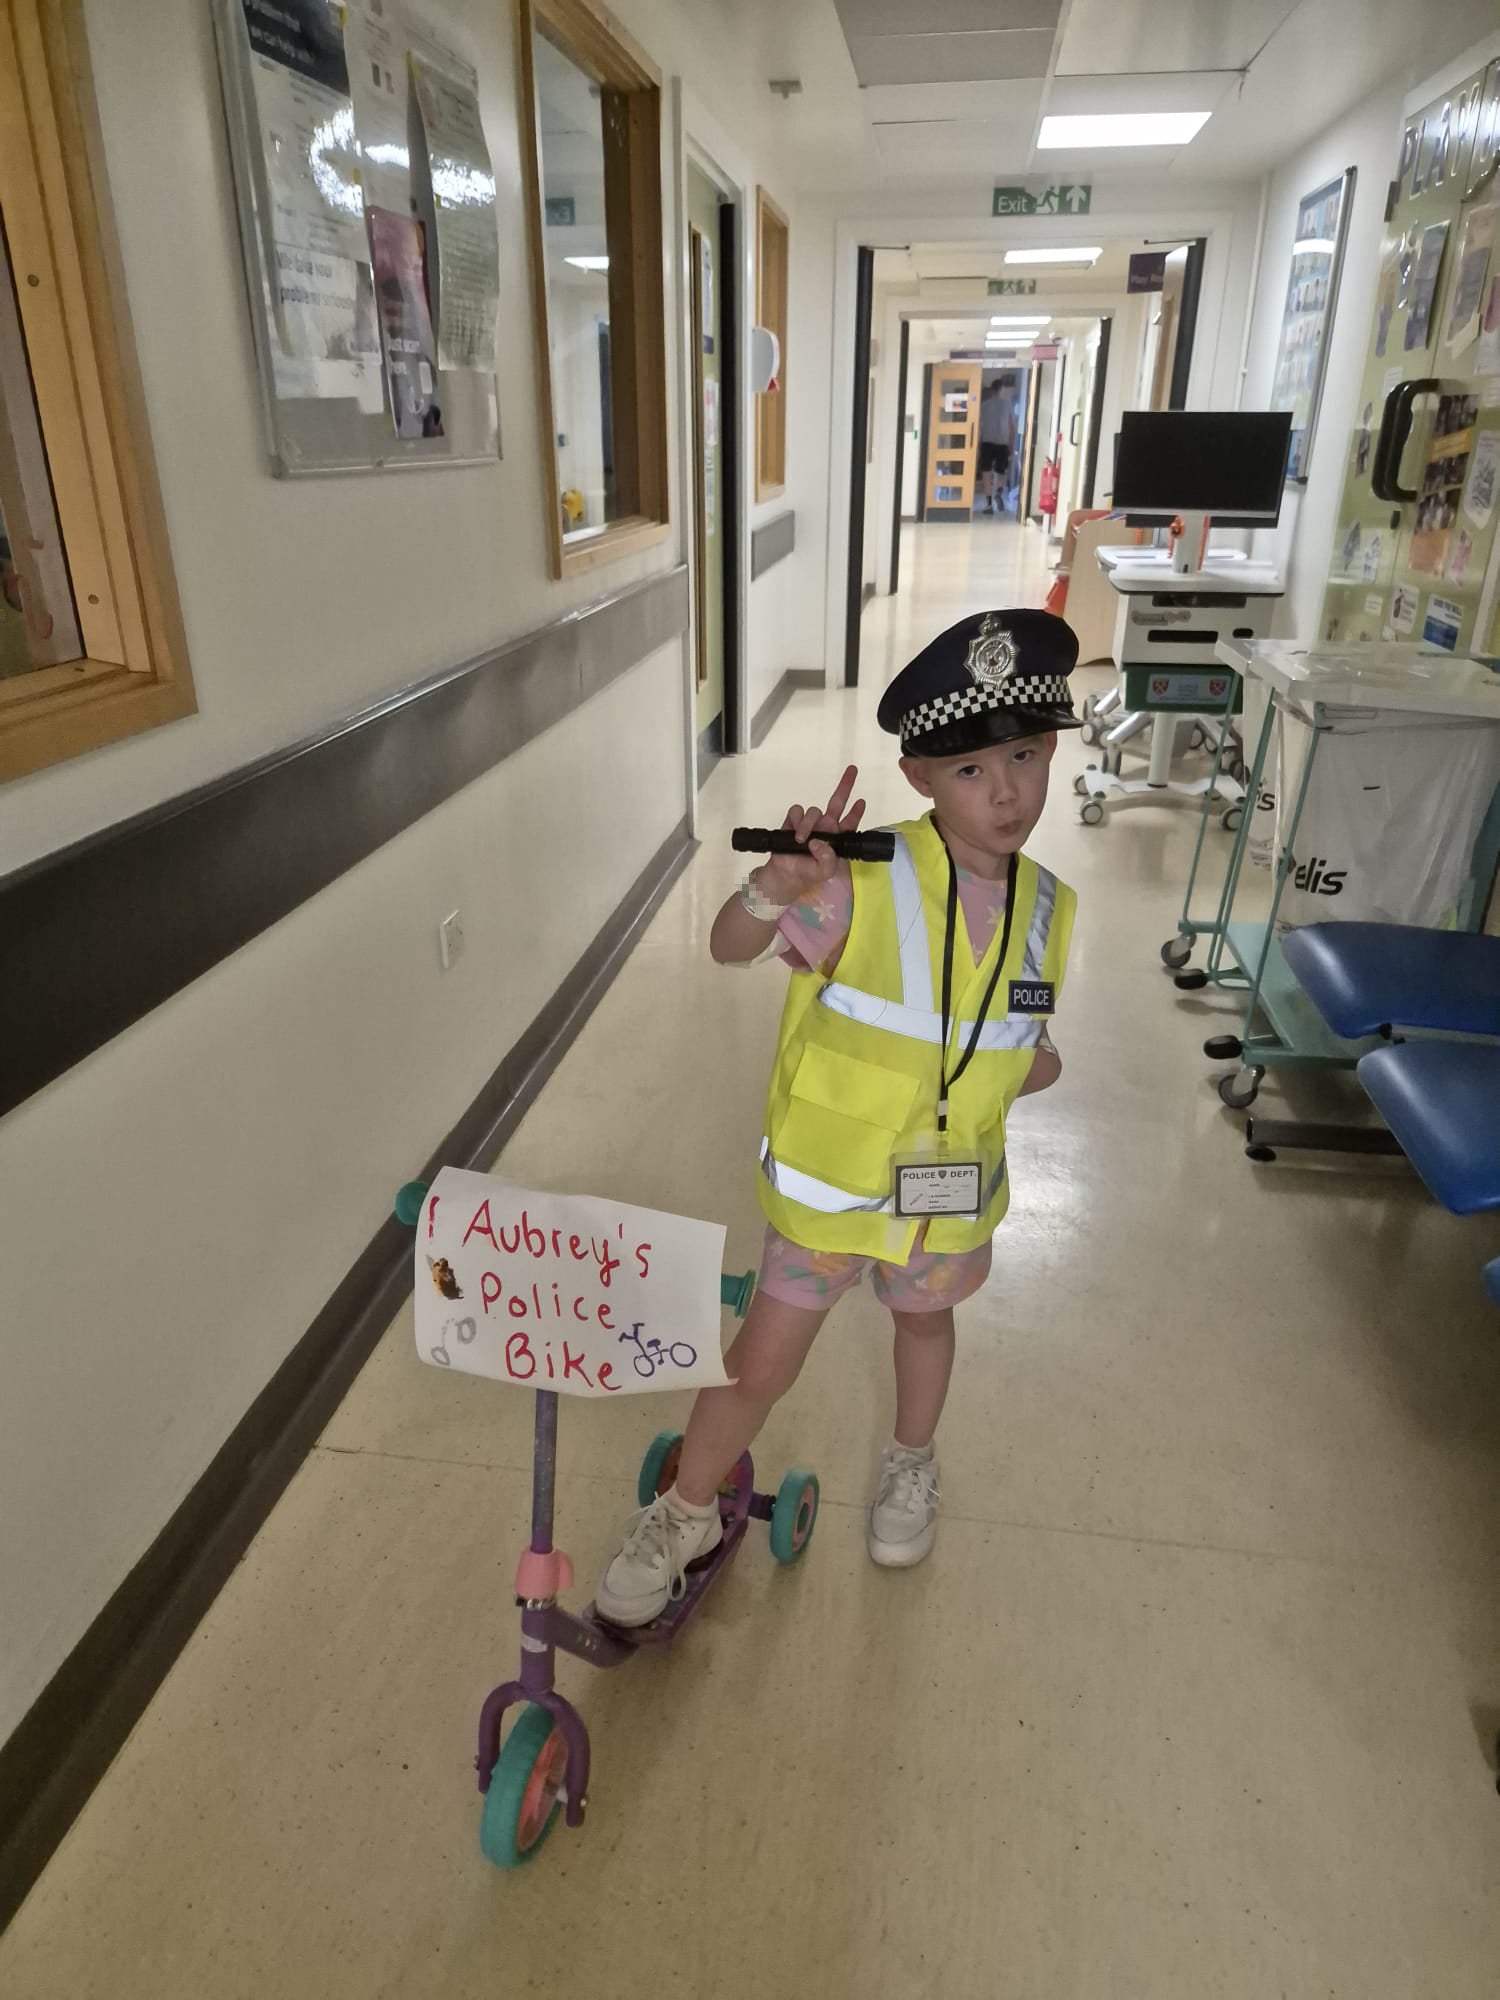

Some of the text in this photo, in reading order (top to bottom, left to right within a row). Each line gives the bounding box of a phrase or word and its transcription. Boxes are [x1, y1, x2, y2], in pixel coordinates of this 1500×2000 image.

[998, 196, 1028, 213] Exit
[1295, 857, 1348, 896] elis
[1013, 988, 1050, 1006] POLICE
[903, 1171, 936, 1180] POLICE
[461, 1198, 653, 1288] Aubrey's
[480, 1271, 615, 1330] Police
[504, 1331, 623, 1391] Bike
